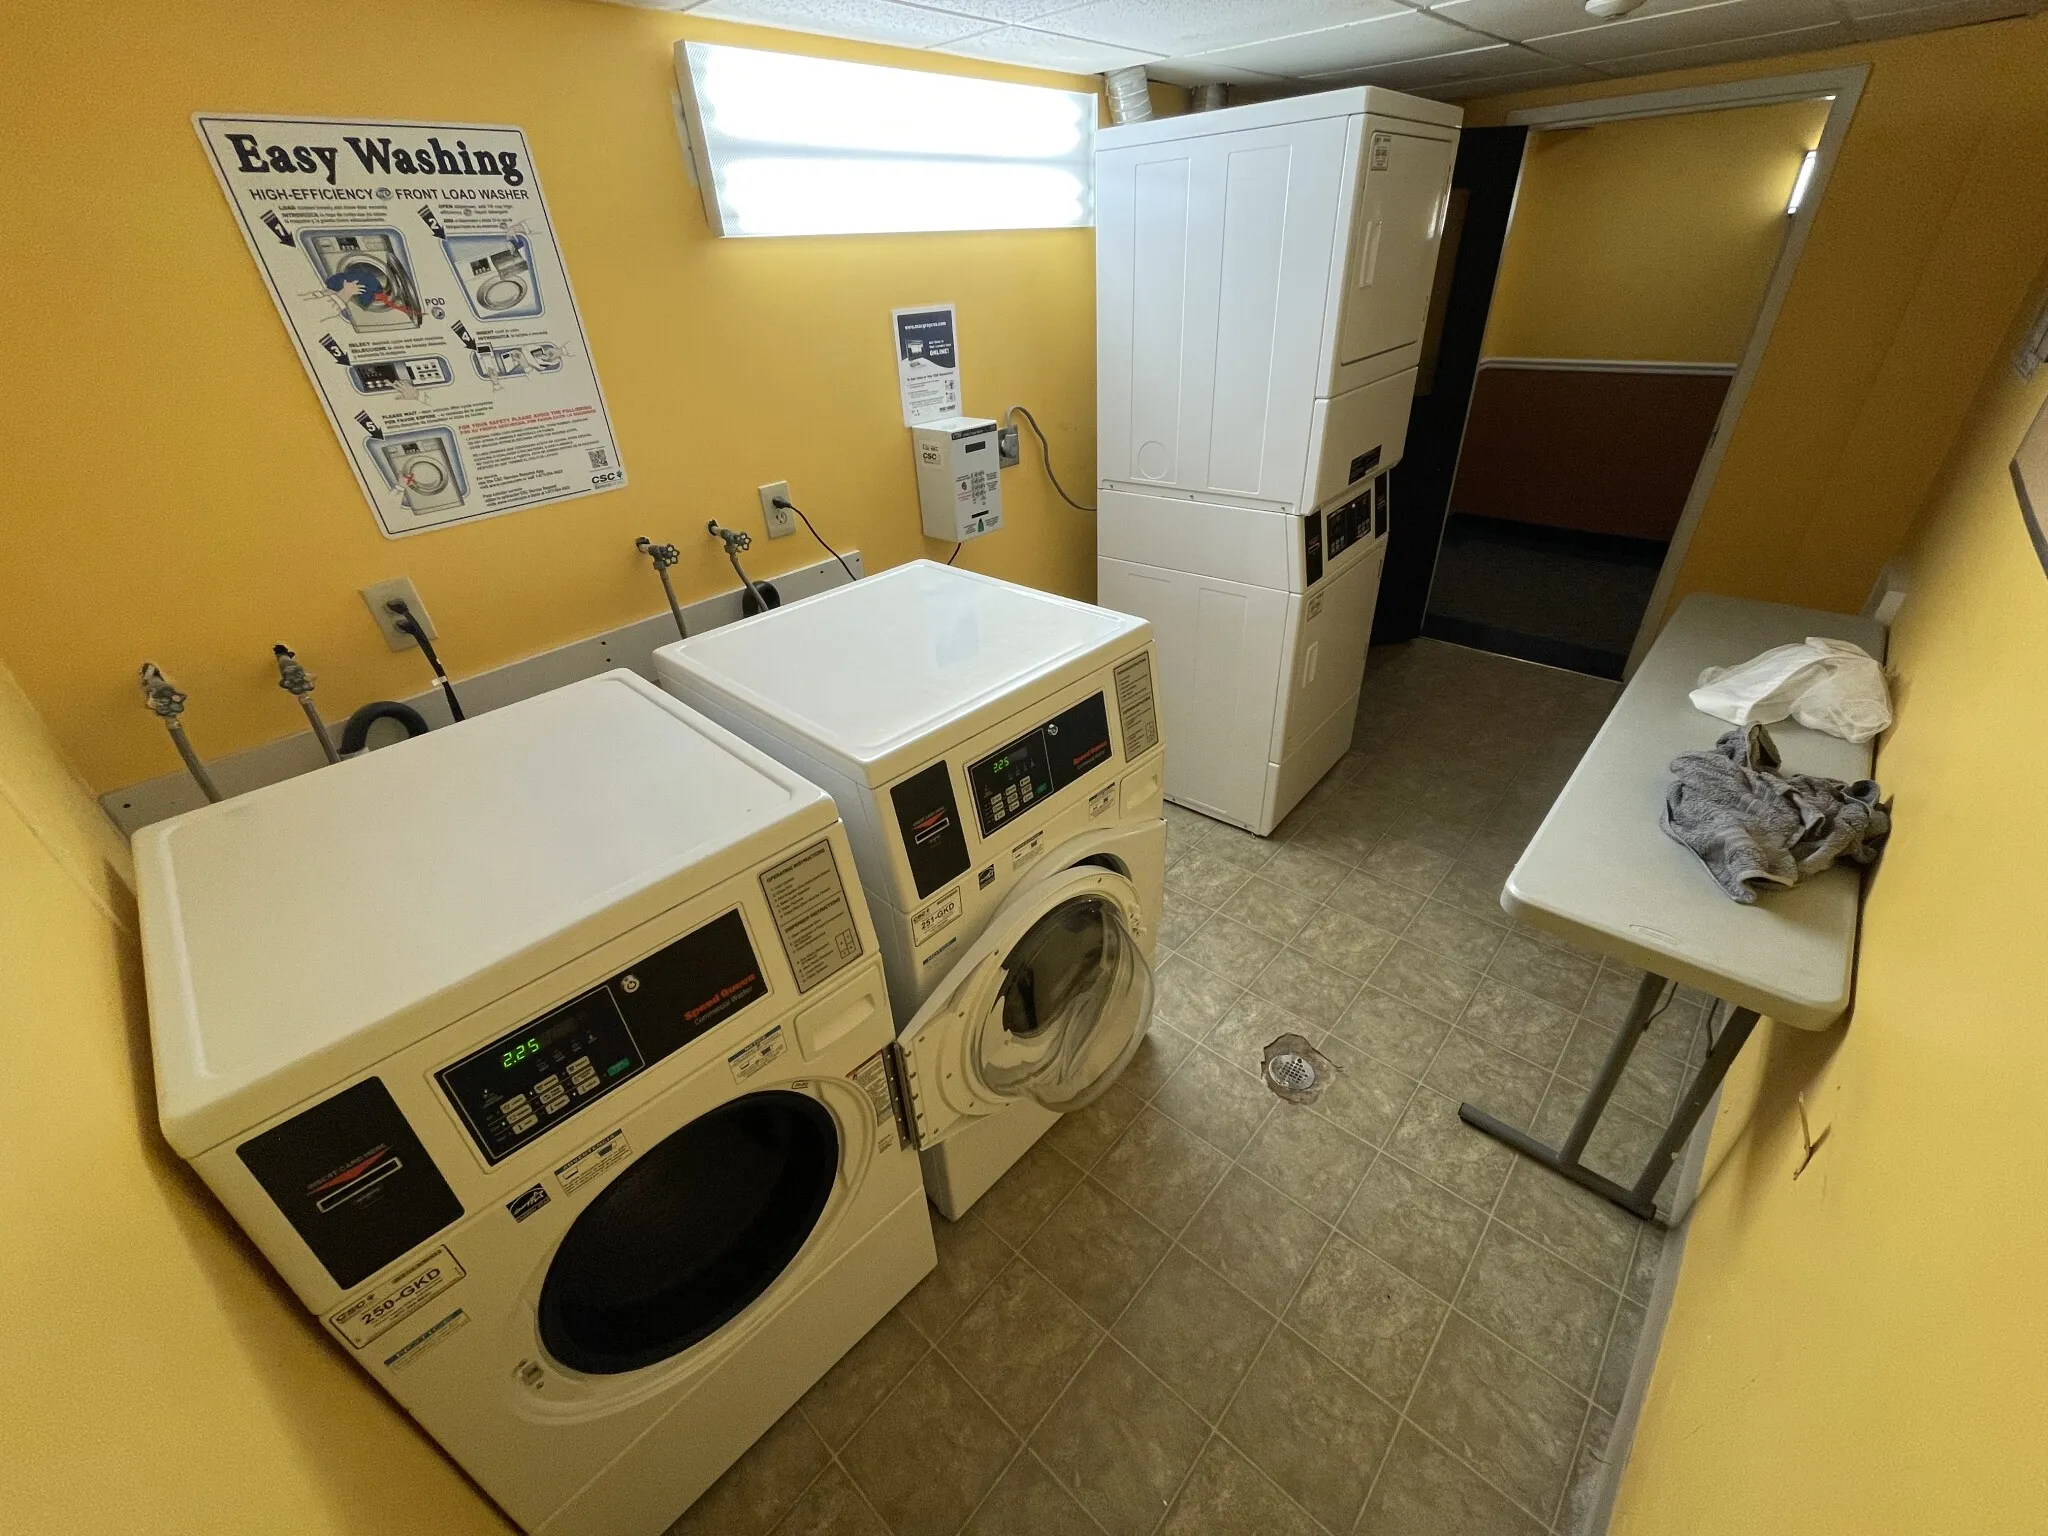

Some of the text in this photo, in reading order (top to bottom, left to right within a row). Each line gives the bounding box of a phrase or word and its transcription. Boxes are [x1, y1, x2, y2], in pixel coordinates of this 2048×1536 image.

[224, 133, 524, 186] Easy Washing
[249, 188, 374, 201] HIGH-EFFICIENCY
[395, 188, 439, 201] FRONT
[441, 188, 477, 201] LOAD
[478, 188, 530, 201] WASHER
[274, 223, 286, 237] 1
[428, 218, 440, 230] 2
[425, 298, 446, 307] POD
[462, 331, 471, 342] 4
[330, 346, 342, 357] 3
[365, 421, 376, 432] 5
[591, 473, 616, 484] CSC
[921, 902, 955, 930] 251-GKD
[684, 973, 756, 1021] Speed Queen
[731, 986, 753, 1003] Washer
[503, 1037, 540, 1068] 2.25
[361, 1268, 441, 1326] 250-GKD
[336, 1300, 366, 1323] CSC
